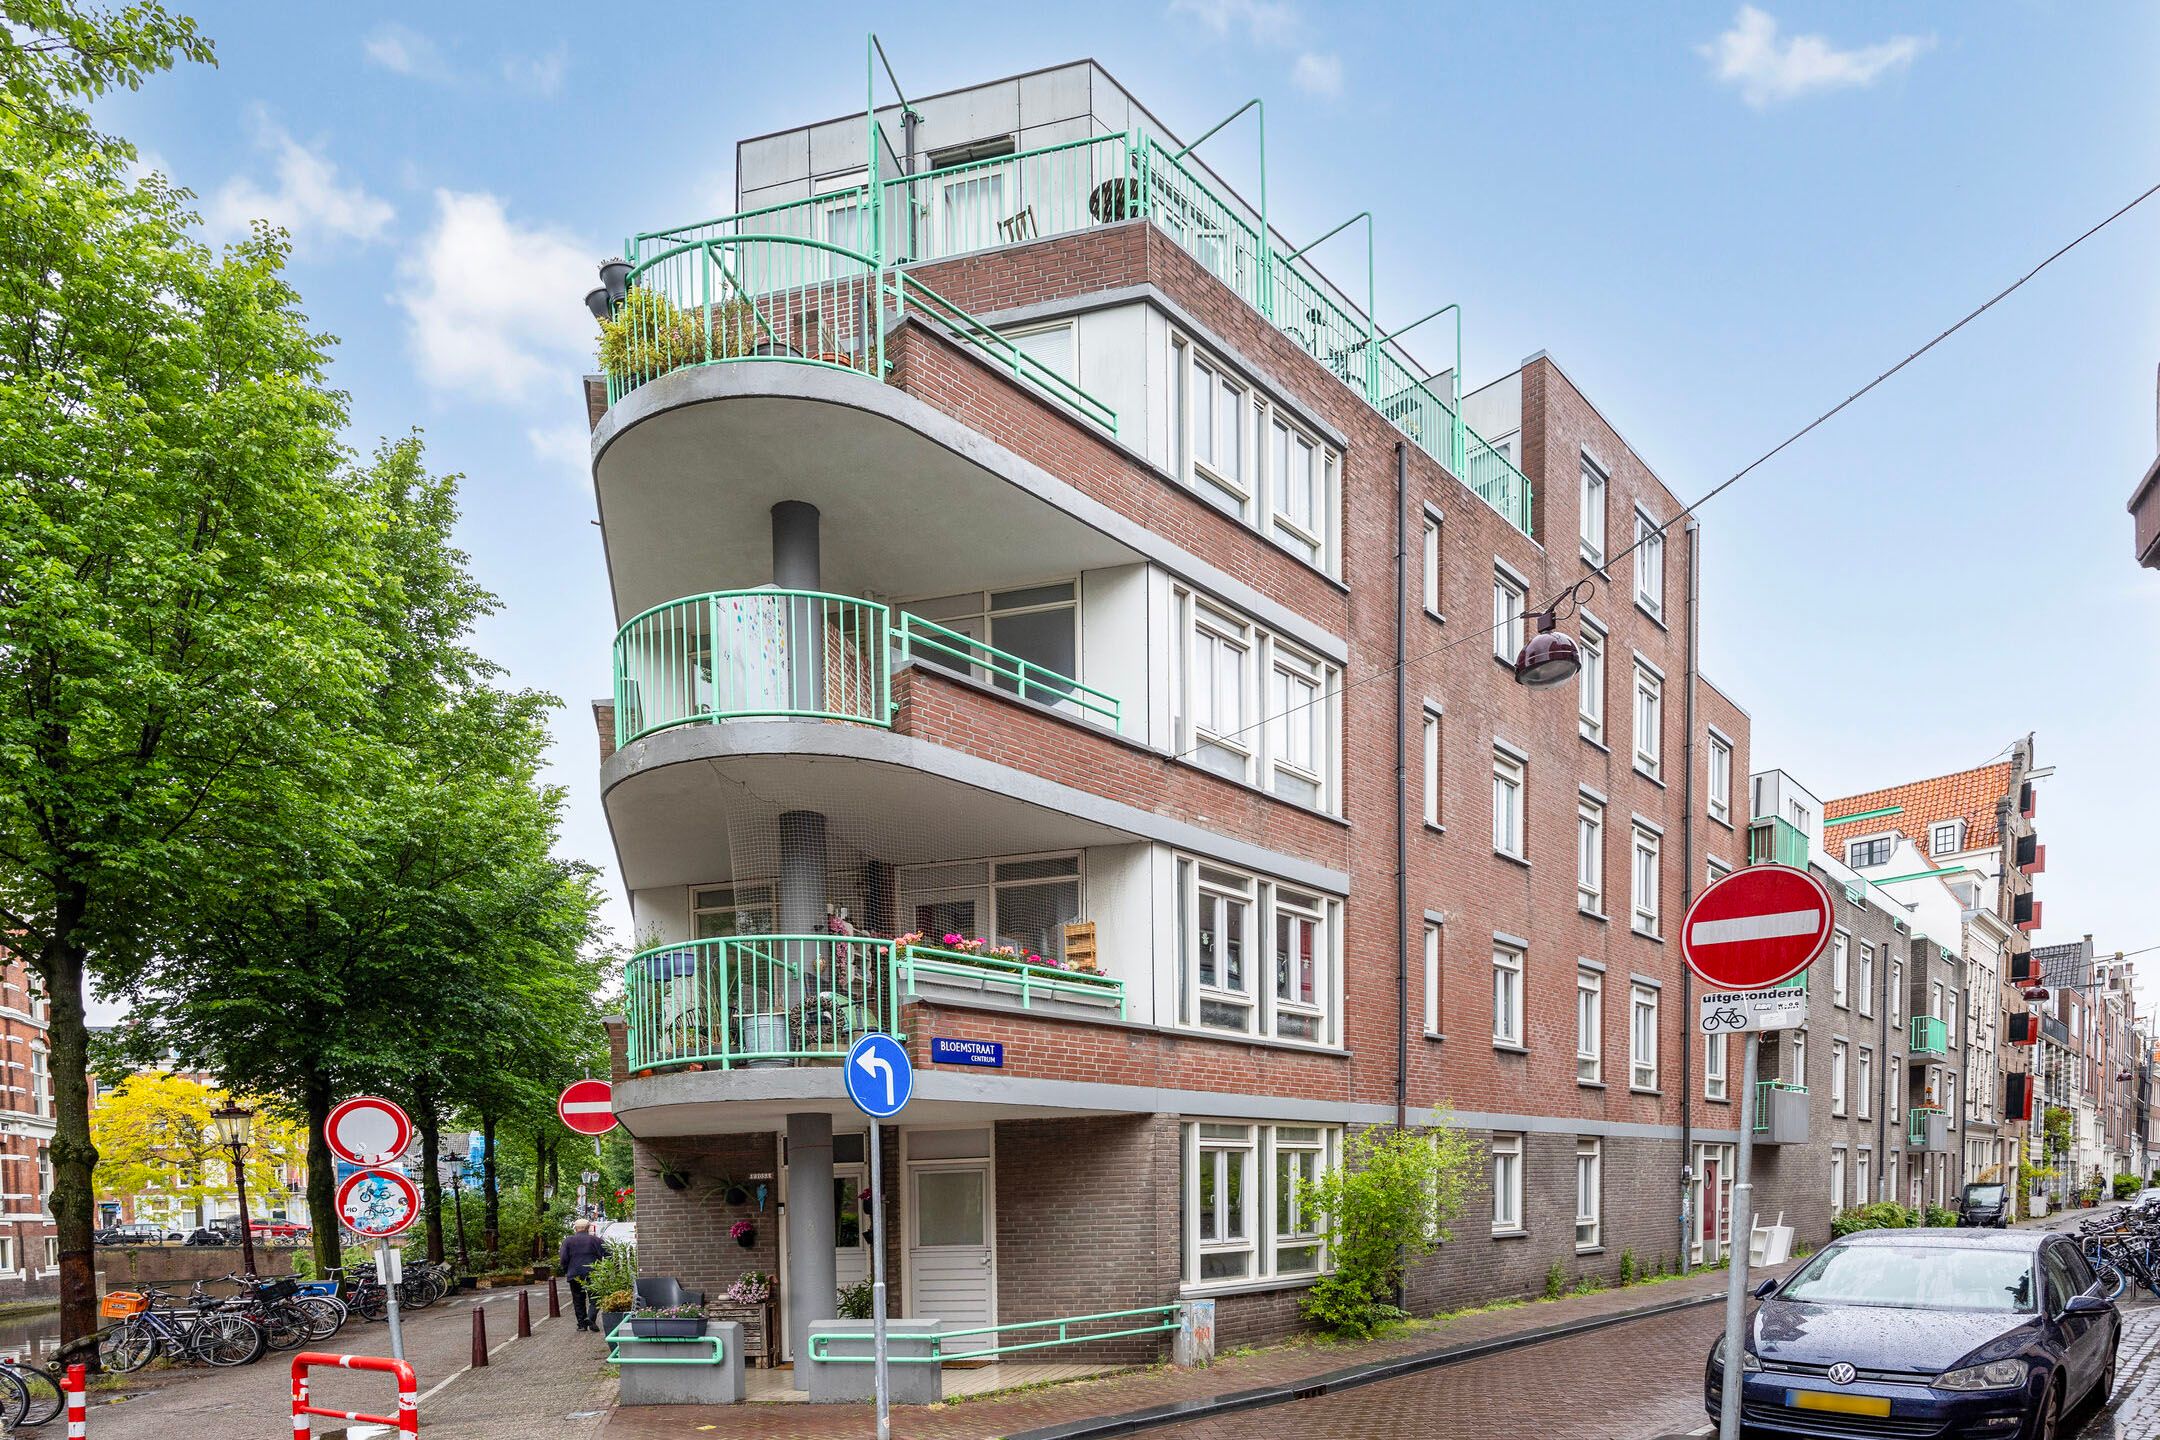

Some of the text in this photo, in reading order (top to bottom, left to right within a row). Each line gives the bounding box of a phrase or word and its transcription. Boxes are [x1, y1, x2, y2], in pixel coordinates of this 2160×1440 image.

[1702, 987, 1804, 1004] uitgezonderd
[940, 1041, 995, 1055] BLOEMSTRAAT
[970, 1055, 996, 1063] CENTRUM
